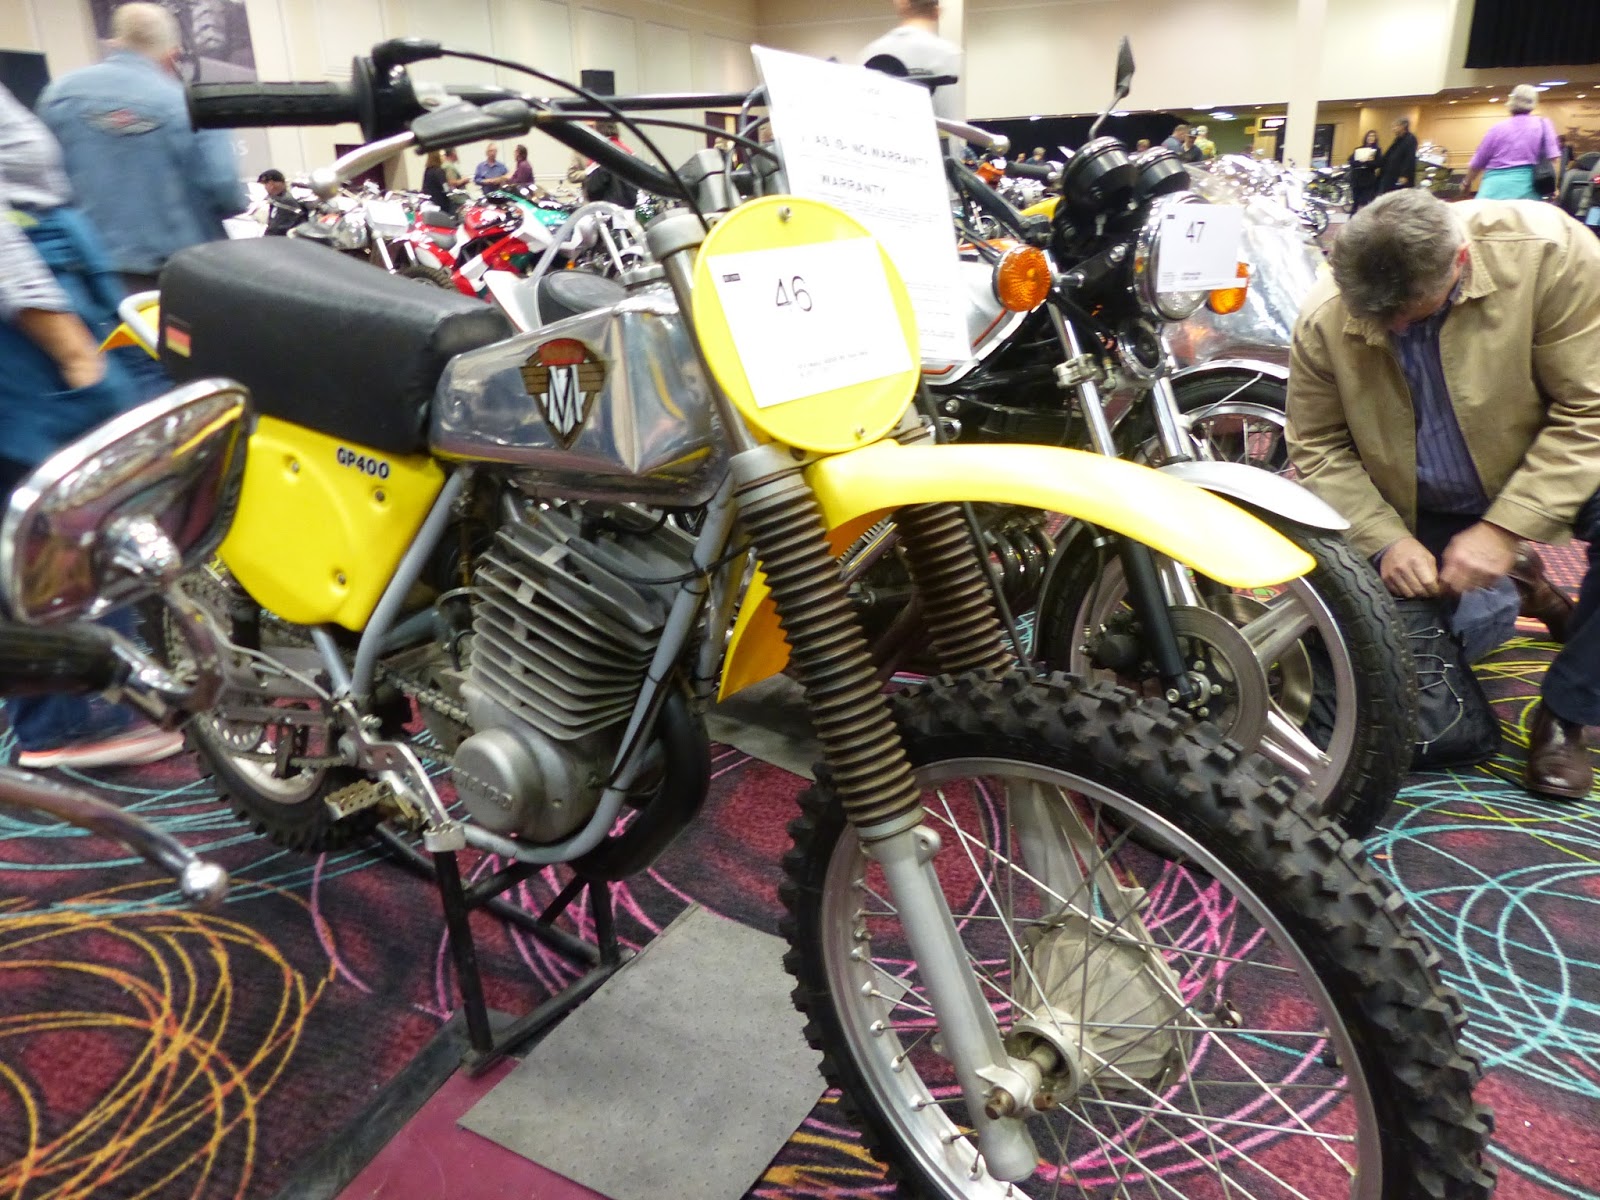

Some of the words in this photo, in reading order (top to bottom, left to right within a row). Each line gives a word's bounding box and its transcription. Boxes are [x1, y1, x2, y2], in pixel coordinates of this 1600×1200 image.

[815, 135, 830, 147] AS
[851, 143, 868, 156] NO
[871, 147, 929, 168] WARRANTY
[820, 174, 886, 197] WARRANTY
[1185, 221, 1206, 244] 47
[775, 275, 813, 312] 46
[336, 446, 390, 480] GP400
